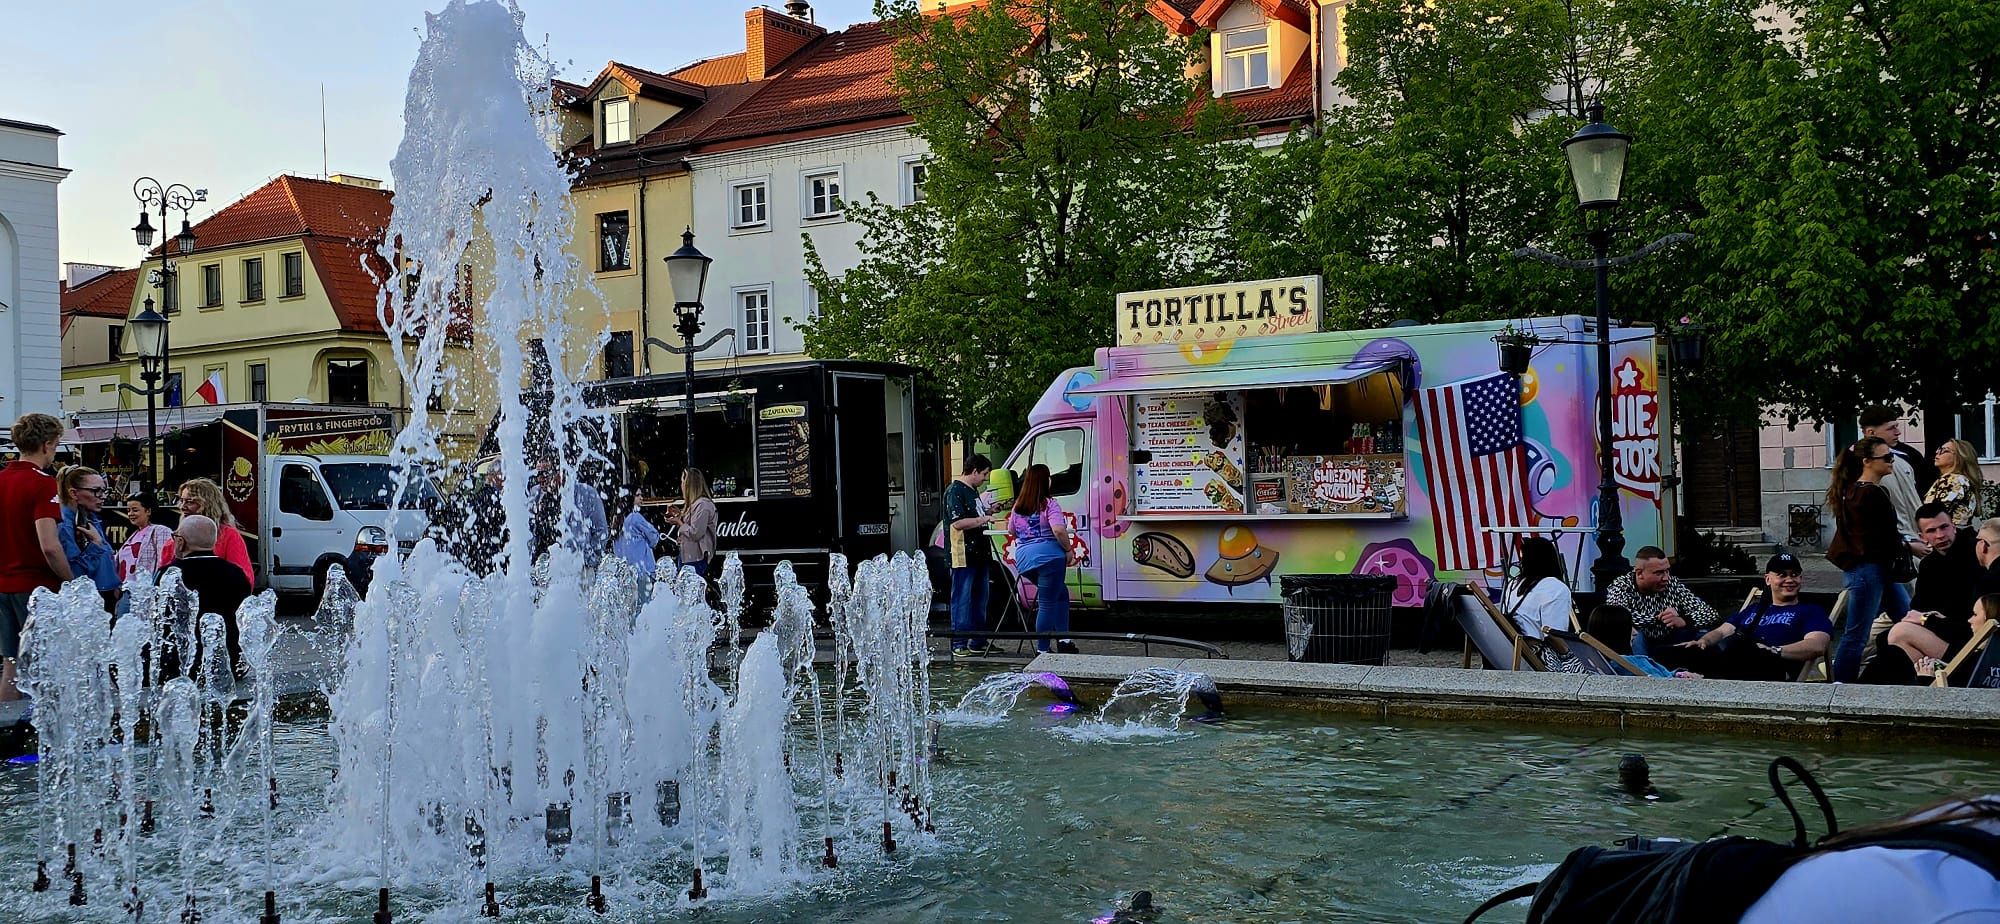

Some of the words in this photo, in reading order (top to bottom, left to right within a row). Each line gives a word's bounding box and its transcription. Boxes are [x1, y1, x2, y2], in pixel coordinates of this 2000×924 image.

[1125, 286, 1308, 330] TORTILLA'S
[1267, 308, 1312, 335] Street
[279, 422, 314, 434] FRYTKI
[316, 422, 323, 430] &
[325, 417, 383, 430] FINGERFOOD
[1171, 460, 1194, 468] CHICKEN
[716, 510, 759, 538] anka
